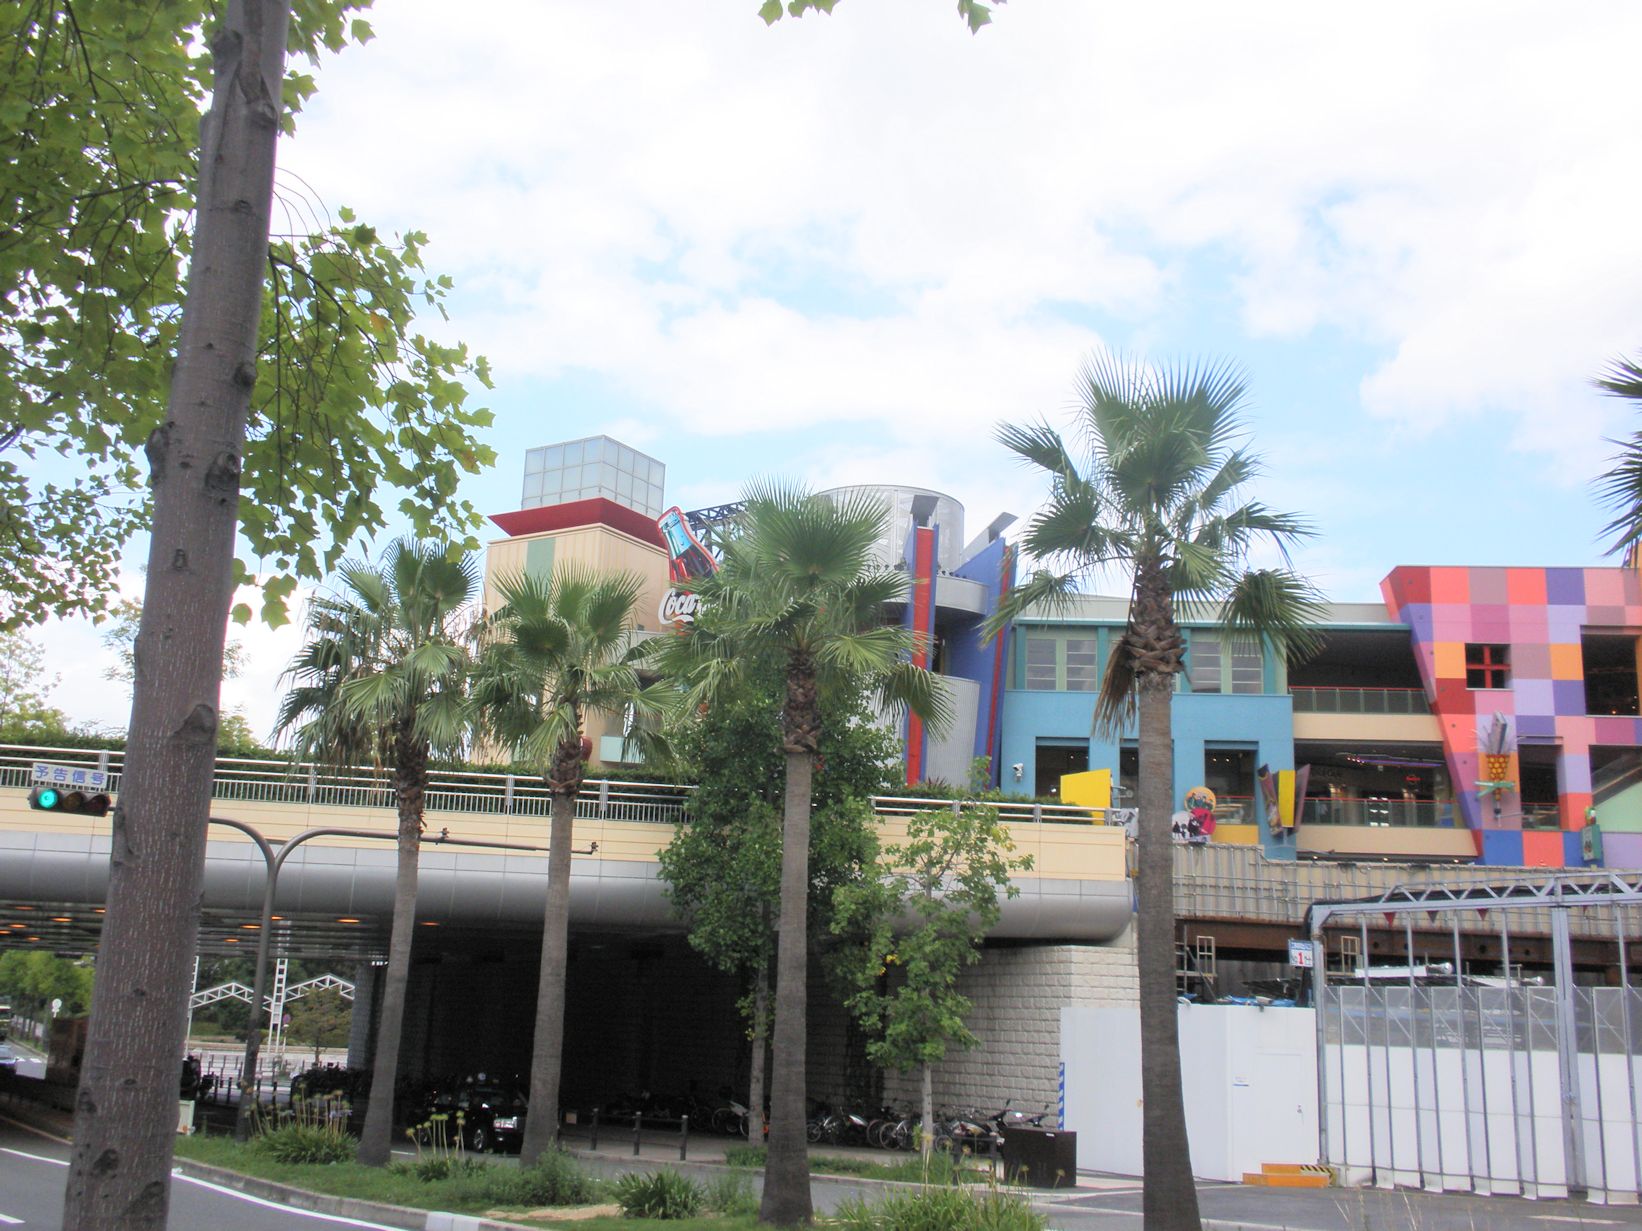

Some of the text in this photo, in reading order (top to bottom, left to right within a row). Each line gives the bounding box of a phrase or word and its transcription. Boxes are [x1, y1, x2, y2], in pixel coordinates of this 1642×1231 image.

[658, 587, 706, 624] Coca
[35, 765, 104, 785] 予告信号
